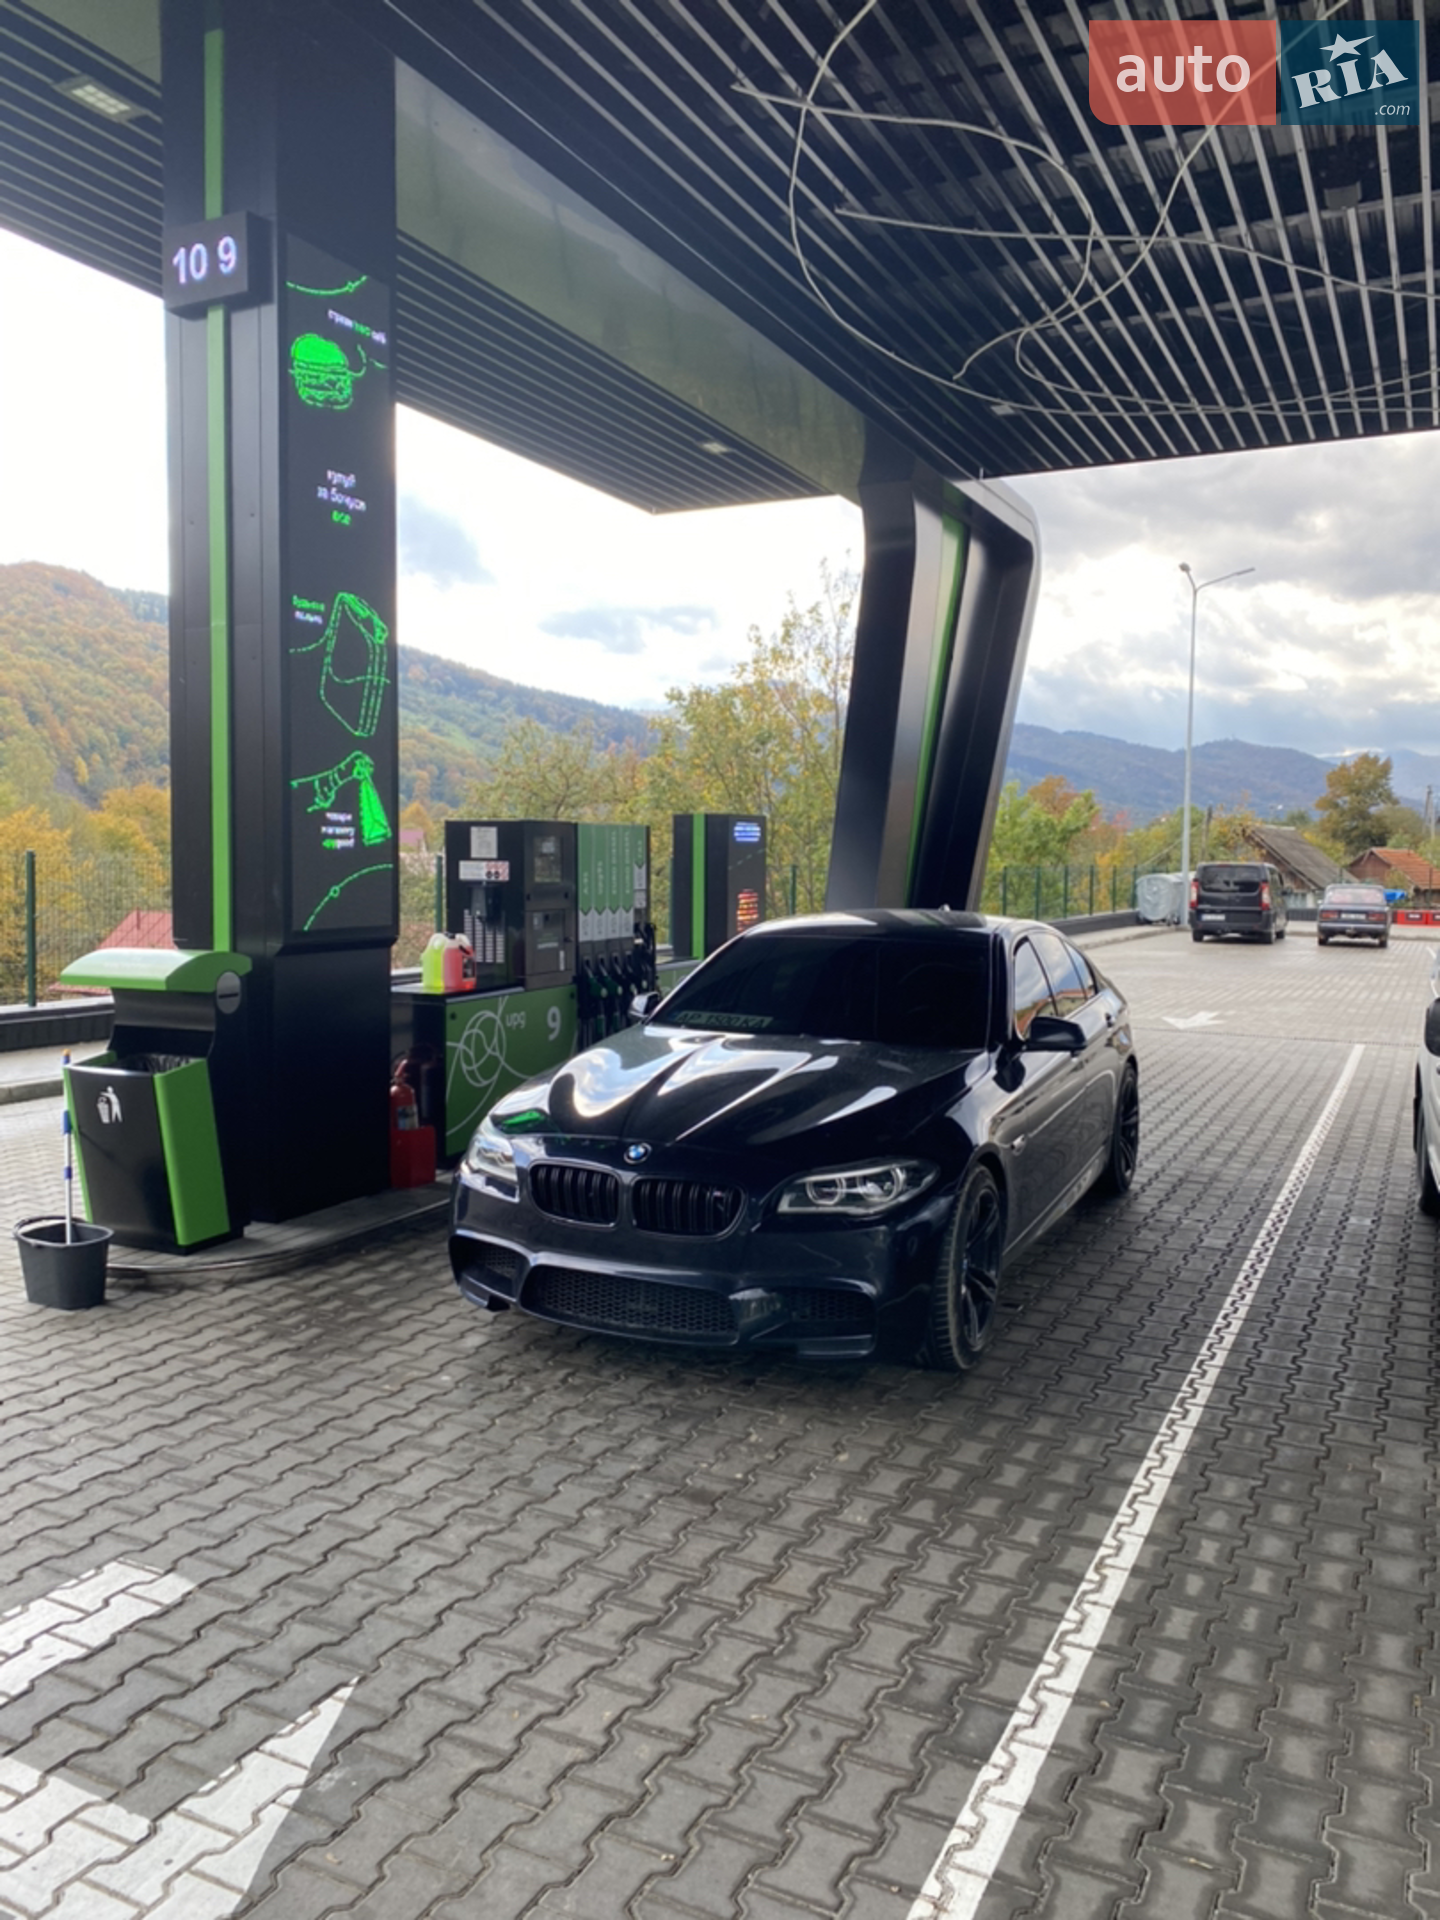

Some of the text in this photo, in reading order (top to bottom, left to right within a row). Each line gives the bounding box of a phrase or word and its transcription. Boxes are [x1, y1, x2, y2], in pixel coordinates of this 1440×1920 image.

[172, 235, 237, 284] 10 9
[505, 1011, 527, 1030] upg
[547, 1005, 561, 1042] 9
